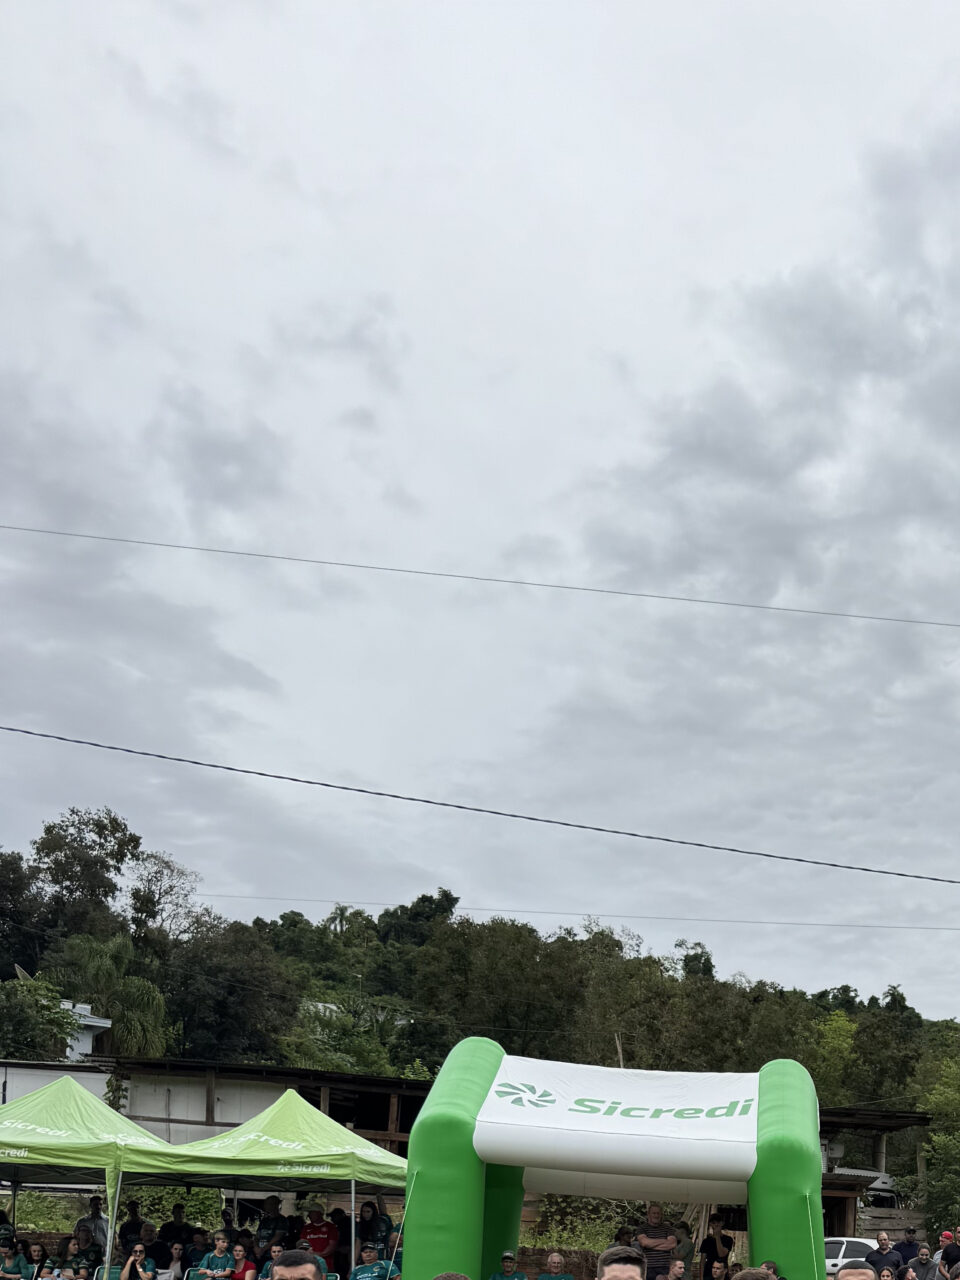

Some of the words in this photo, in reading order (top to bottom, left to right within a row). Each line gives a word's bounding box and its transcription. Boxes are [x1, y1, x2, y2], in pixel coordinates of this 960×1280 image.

[568, 1097, 755, 1119] Sicredi
[0, 1119, 72, 1137] Sicredi
[292, 1164, 331, 1174] Sicredi
